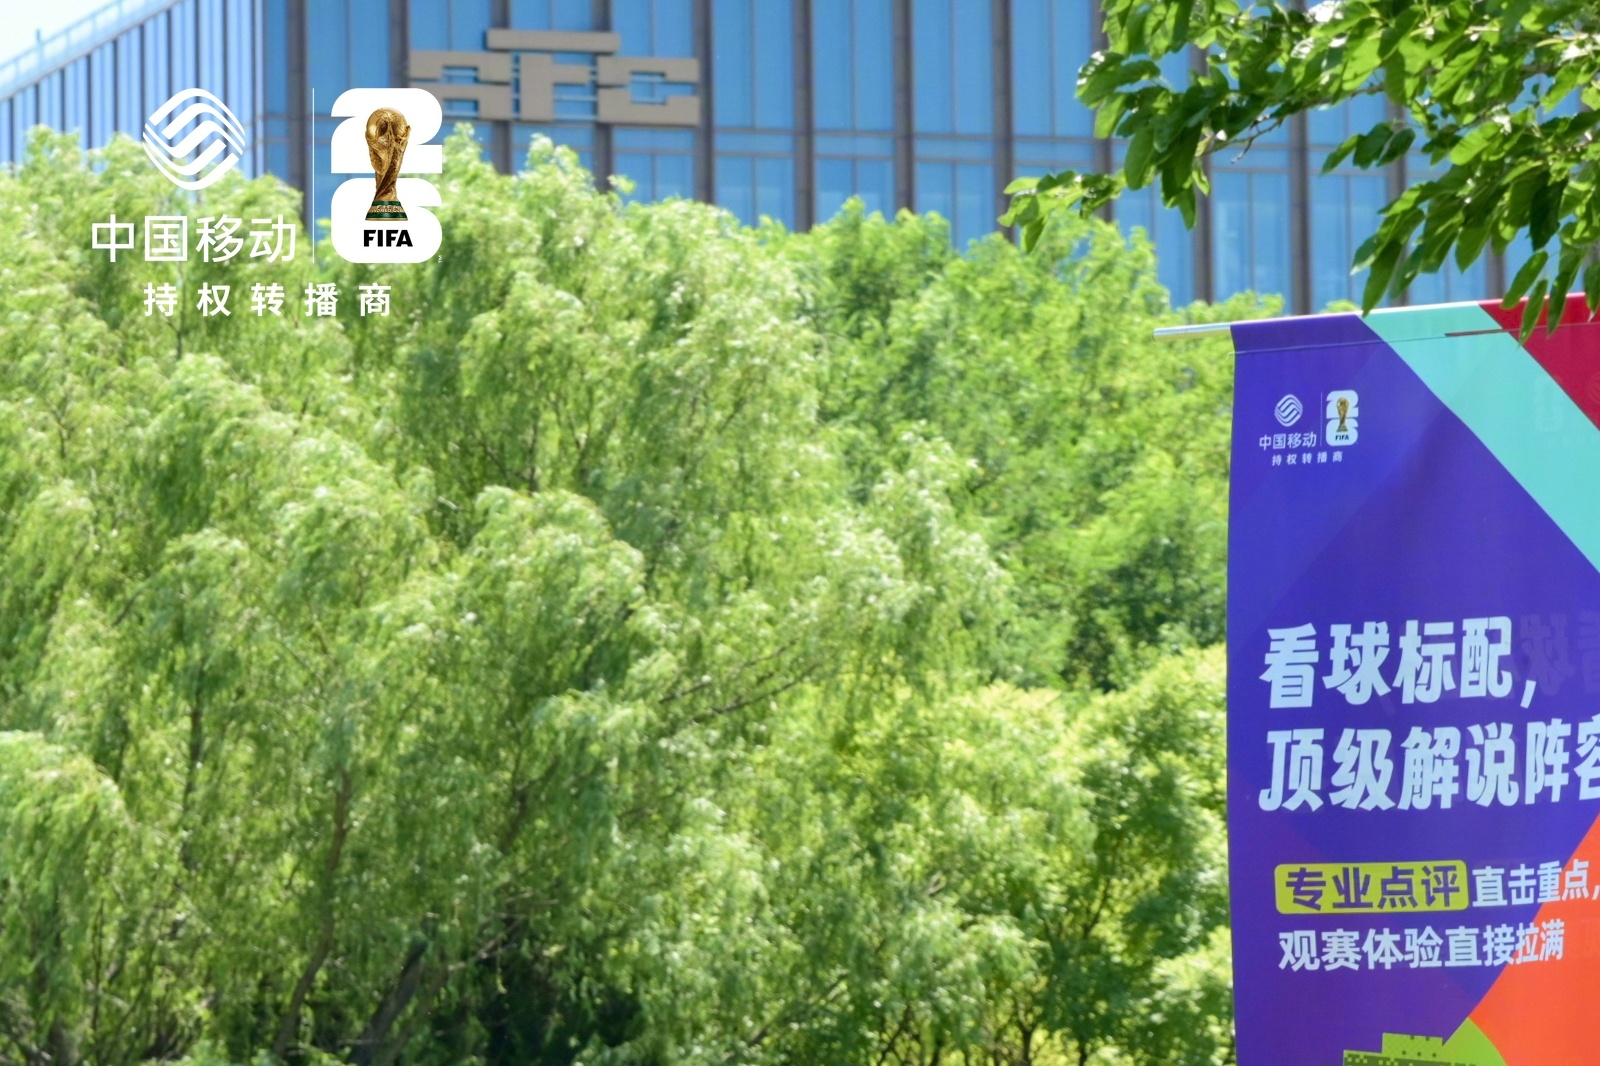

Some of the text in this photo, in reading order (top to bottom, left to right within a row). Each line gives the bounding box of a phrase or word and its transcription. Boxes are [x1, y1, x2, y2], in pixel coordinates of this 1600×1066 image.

[1258, 431, 1318, 451] 中国移动
[1271, 450, 1343, 467] 持权转播商
[1259, 616, 1537, 709] 看球标配，
[1278, 917, 1566, 973] 观赛体验直接拉满
